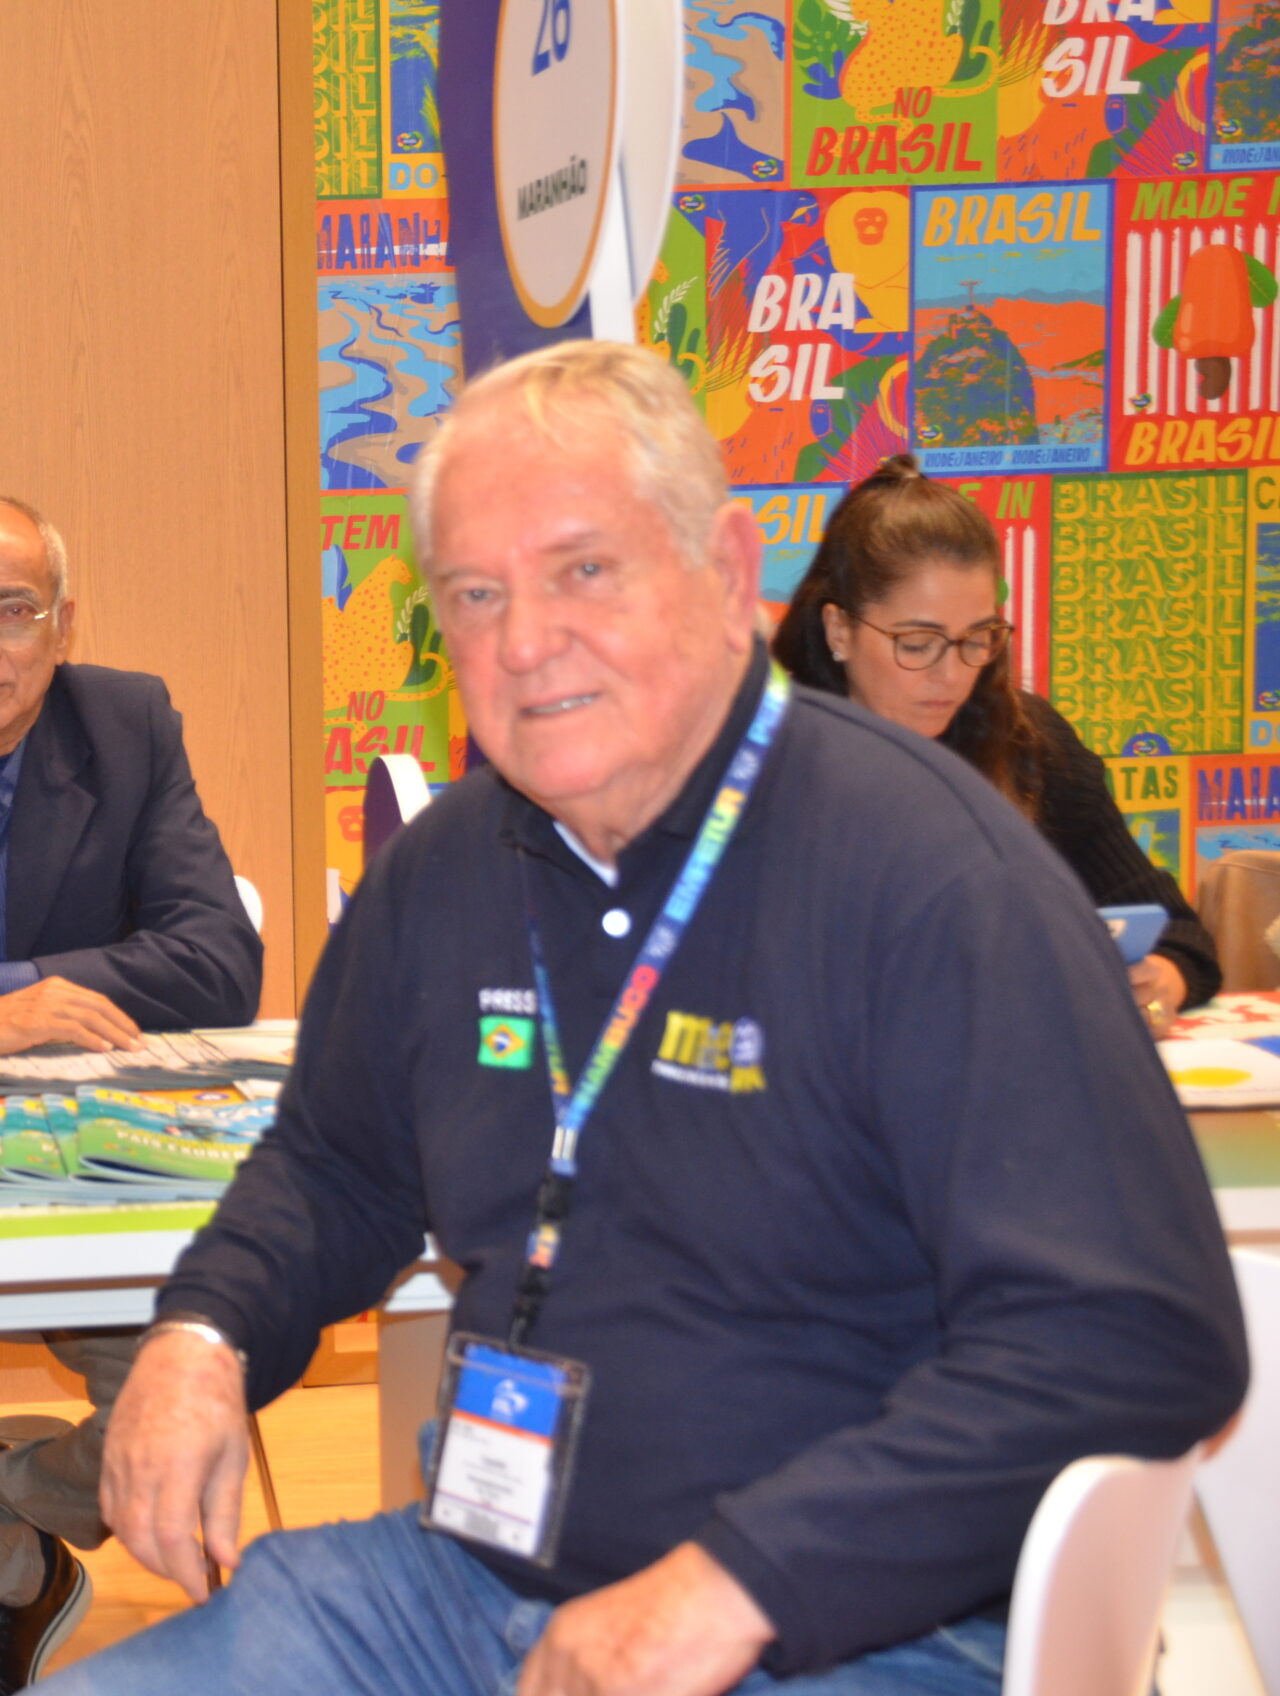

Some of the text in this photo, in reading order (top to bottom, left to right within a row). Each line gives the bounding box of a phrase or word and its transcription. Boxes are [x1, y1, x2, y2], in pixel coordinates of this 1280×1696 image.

[1041, 36, 1141, 98] SIL
[893, 85, 933, 120] NO
[805, 122, 983, 177] BRASIL
[388, 162, 439, 191] DO
[922, 191, 1101, 248] BRASIL
[1130, 177, 1254, 221] MADE
[747, 272, 855, 334] BRA
[748, 343, 846, 403] SIL
[996, 482, 1035, 519] IN
[321, 514, 400, 551] TEM
[346, 690, 385, 722] NO
